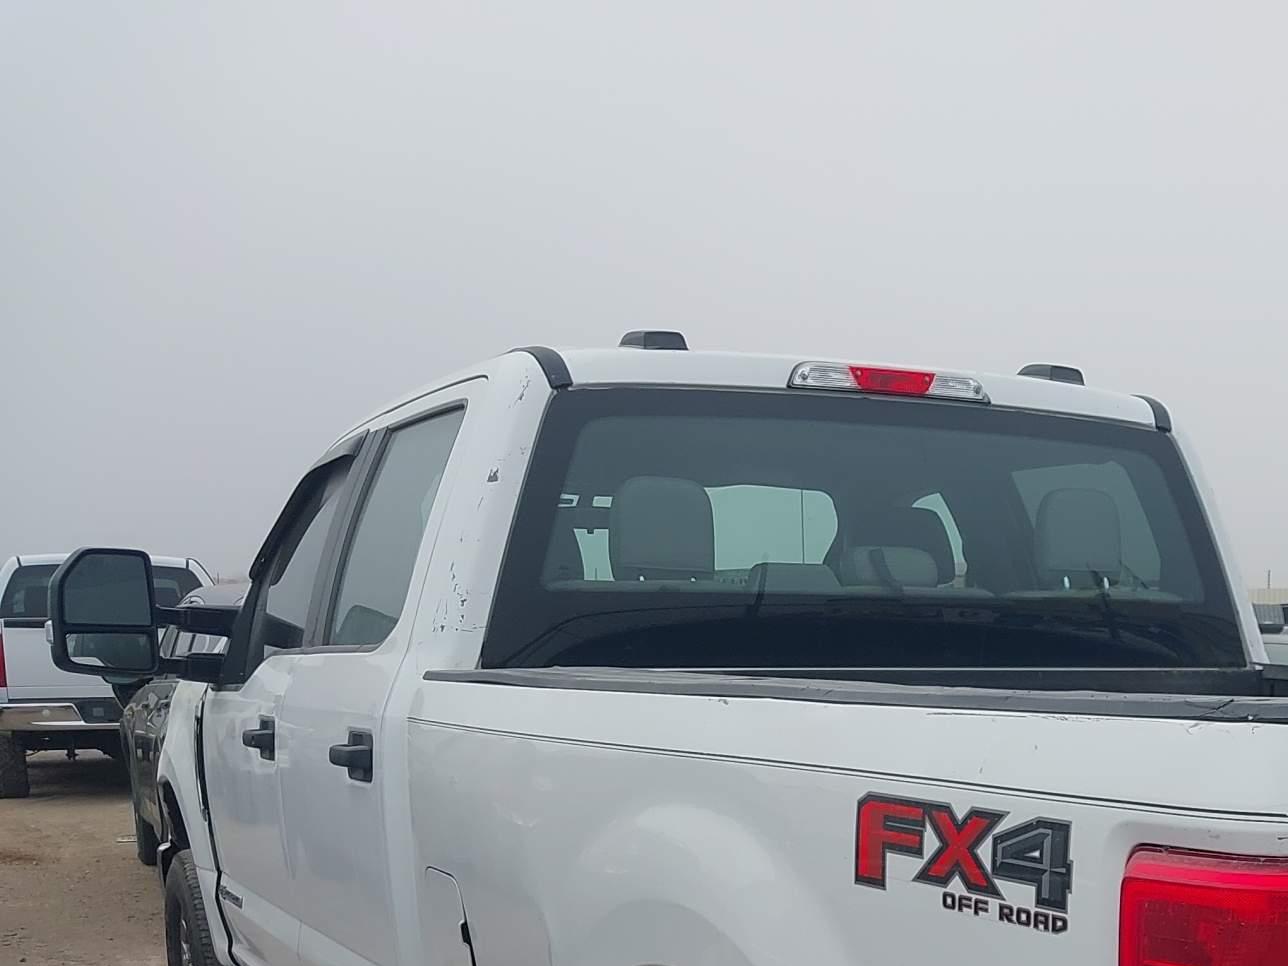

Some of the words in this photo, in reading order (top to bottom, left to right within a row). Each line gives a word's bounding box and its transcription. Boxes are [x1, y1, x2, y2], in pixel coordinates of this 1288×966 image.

[855, 791, 1073, 914] FX4
[942, 891, 989, 917] OFF
[999, 903, 1068, 934] ROAD
